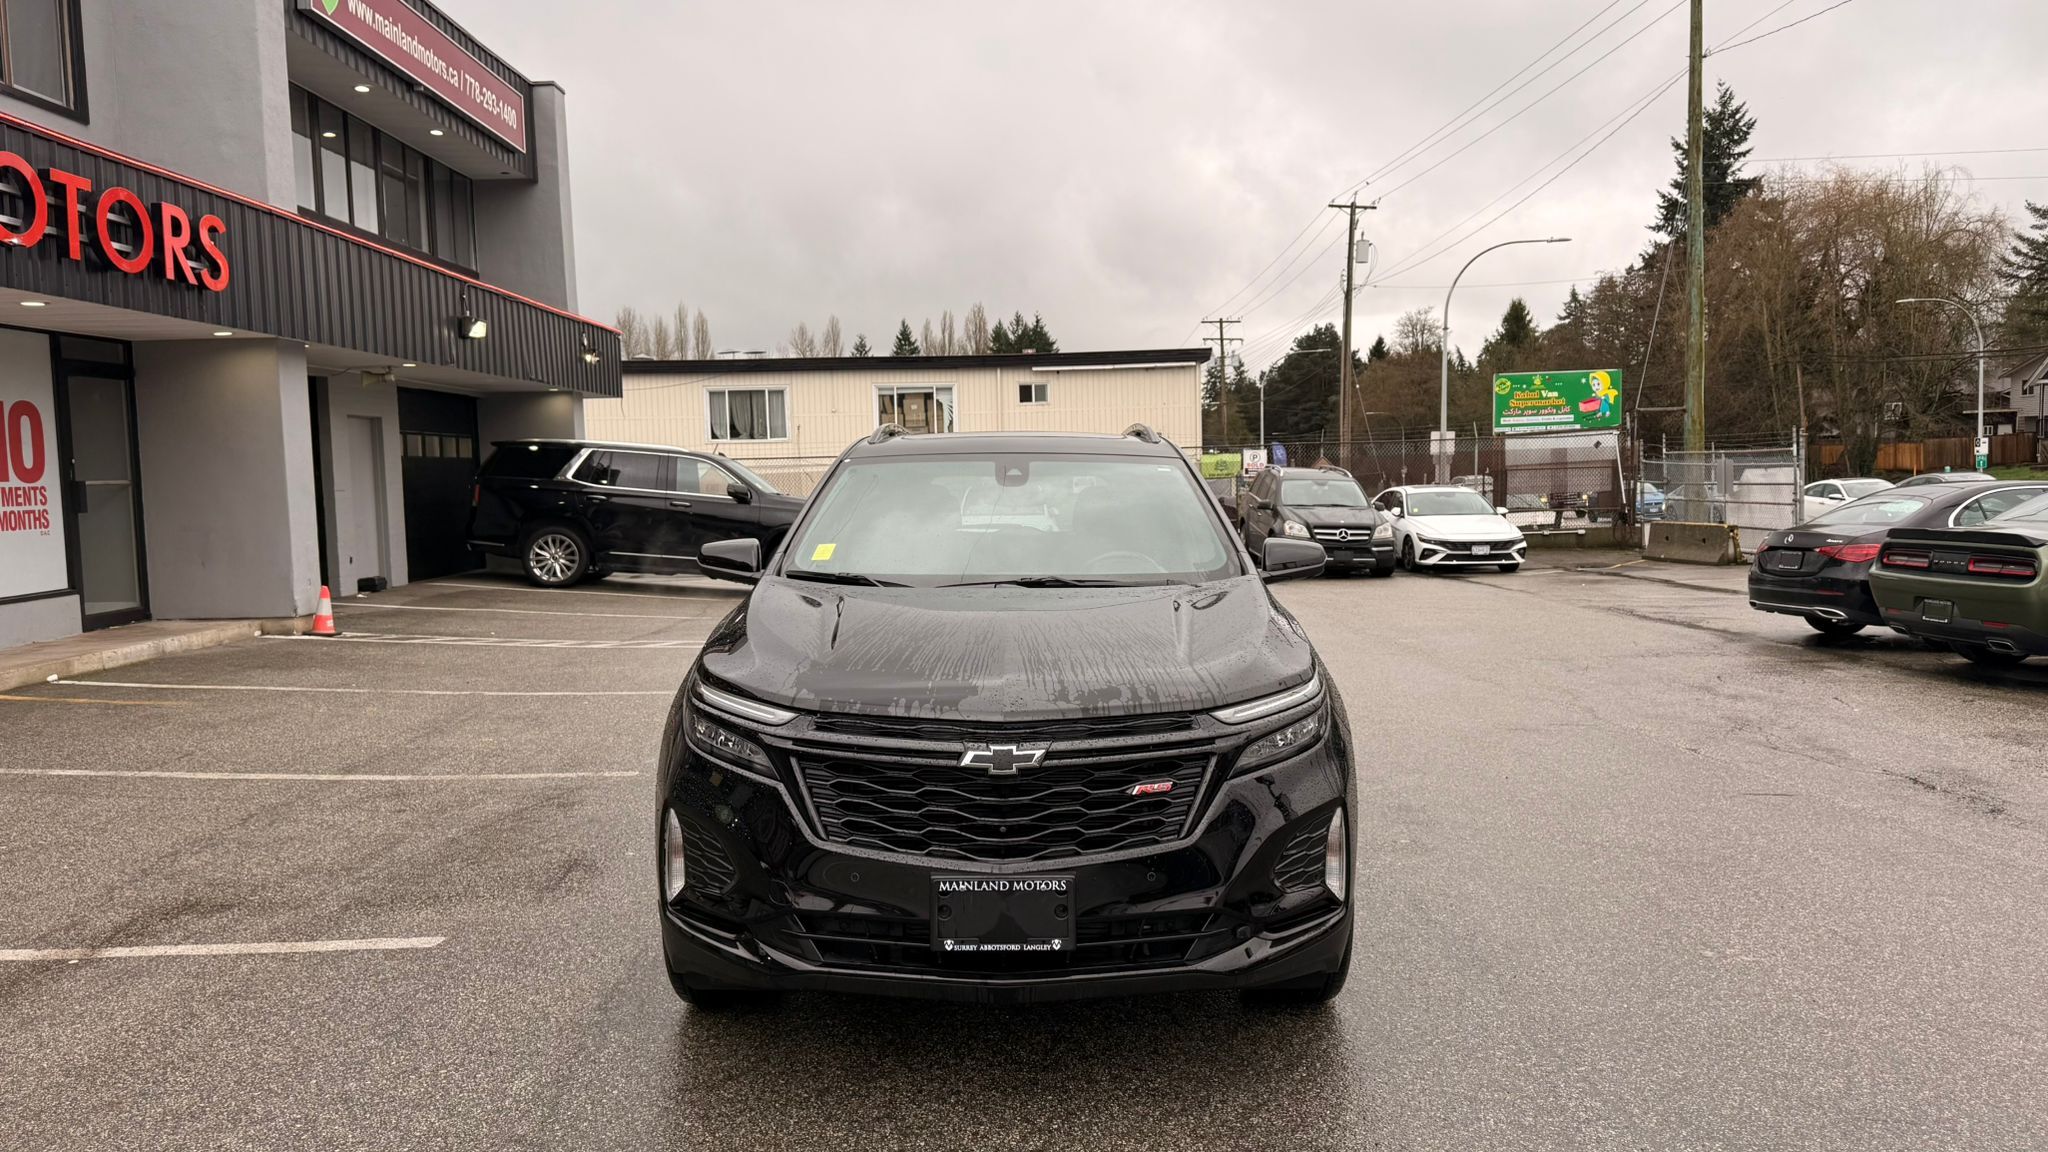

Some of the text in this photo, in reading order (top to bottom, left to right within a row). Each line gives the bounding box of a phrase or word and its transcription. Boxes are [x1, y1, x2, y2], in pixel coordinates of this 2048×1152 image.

[347, 0, 459, 88] www.mainlandmotors.ca
[465, 74, 517, 130] 778-293-1400
[1541, 390, 1559, 398] Van
[1509, 397, 1566, 408] Supermarket
[0, 486, 48, 507] MENTS
[939, 880, 1067, 891] MAINLAND MOTORS
